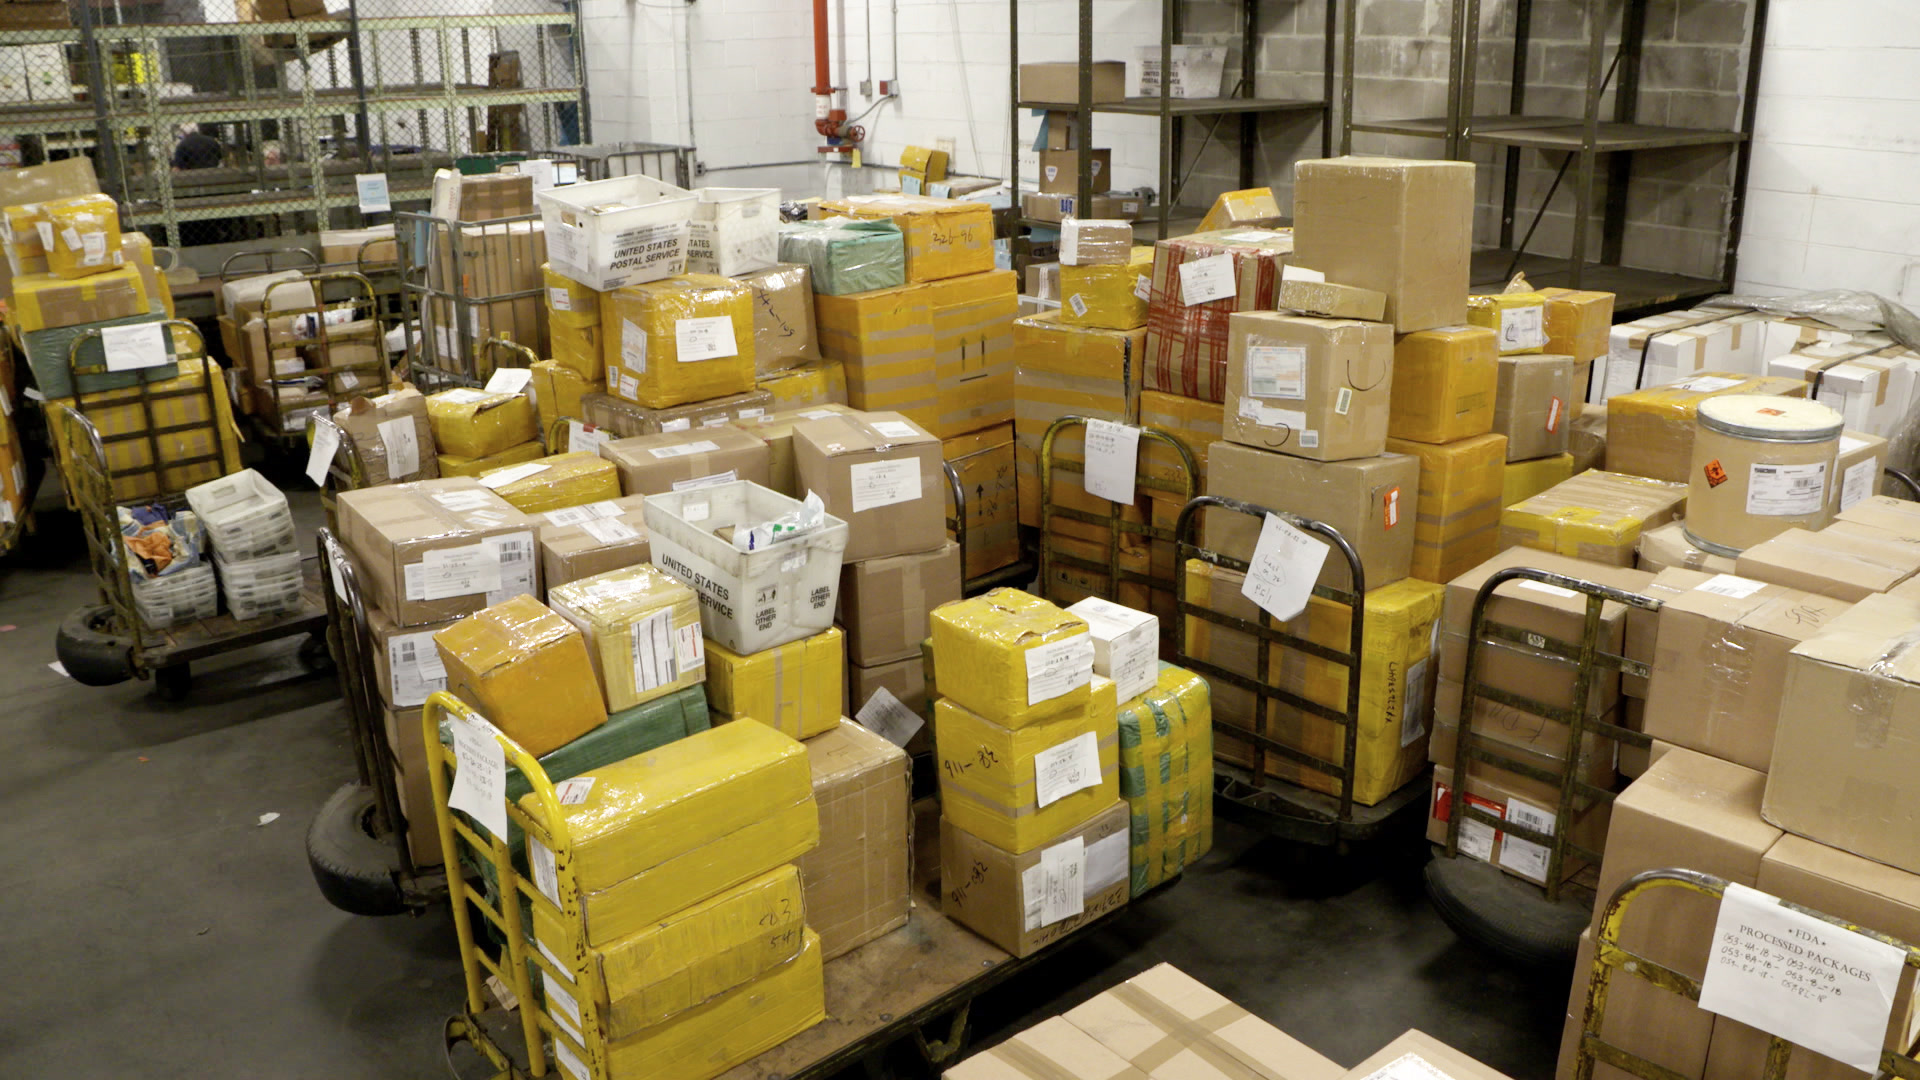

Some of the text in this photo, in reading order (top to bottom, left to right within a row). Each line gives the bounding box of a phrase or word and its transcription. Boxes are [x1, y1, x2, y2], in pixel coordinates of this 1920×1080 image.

[614, 238, 679, 259] UNITED STATES
[609, 257, 643, 271] POSTAL
[645, 248, 681, 263] SERVICE
[662, 554, 729, 601] UNITED STATES
[811, 585, 831, 596] LABEL
[809, 592, 831, 604] OTHER
[813, 600, 826, 609] END
[755, 607, 776, 619] LABEL
[755, 613, 777, 626] OTHER
[758, 622, 773, 631] END
[1795, 928, 1819, 946] FDA
[1739, 924, 1872, 982] PROCESSED PACKAGES
